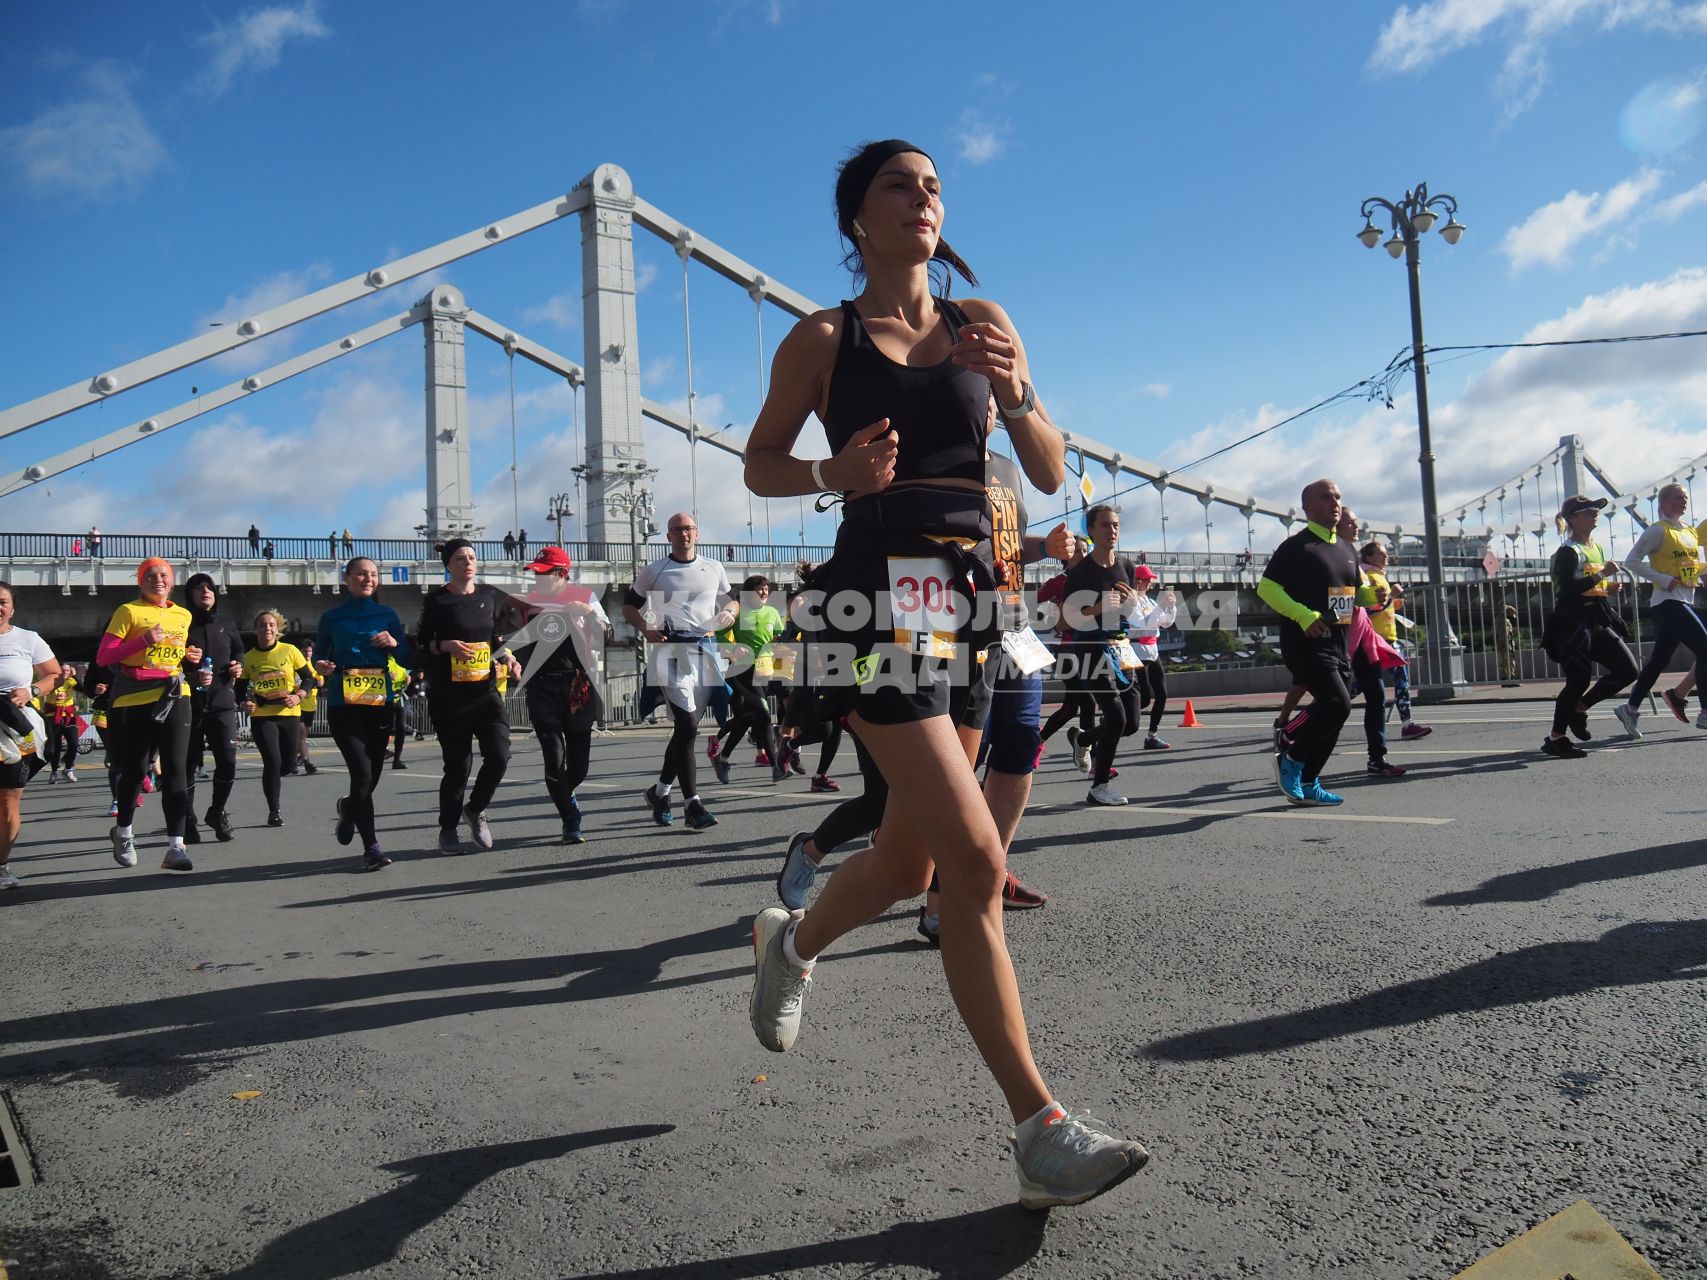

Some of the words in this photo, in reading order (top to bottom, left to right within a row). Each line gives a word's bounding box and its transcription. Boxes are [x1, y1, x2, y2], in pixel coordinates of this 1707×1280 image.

[985, 487, 1015, 500] BERLIN
[991, 501, 1017, 529] FIN
[993, 531, 1020, 561] ISH
[996, 562, 1018, 591] R
[917, 632, 928, 651] F
[256, 678, 286, 690] 28511
[345, 677, 384, 690] 18929
